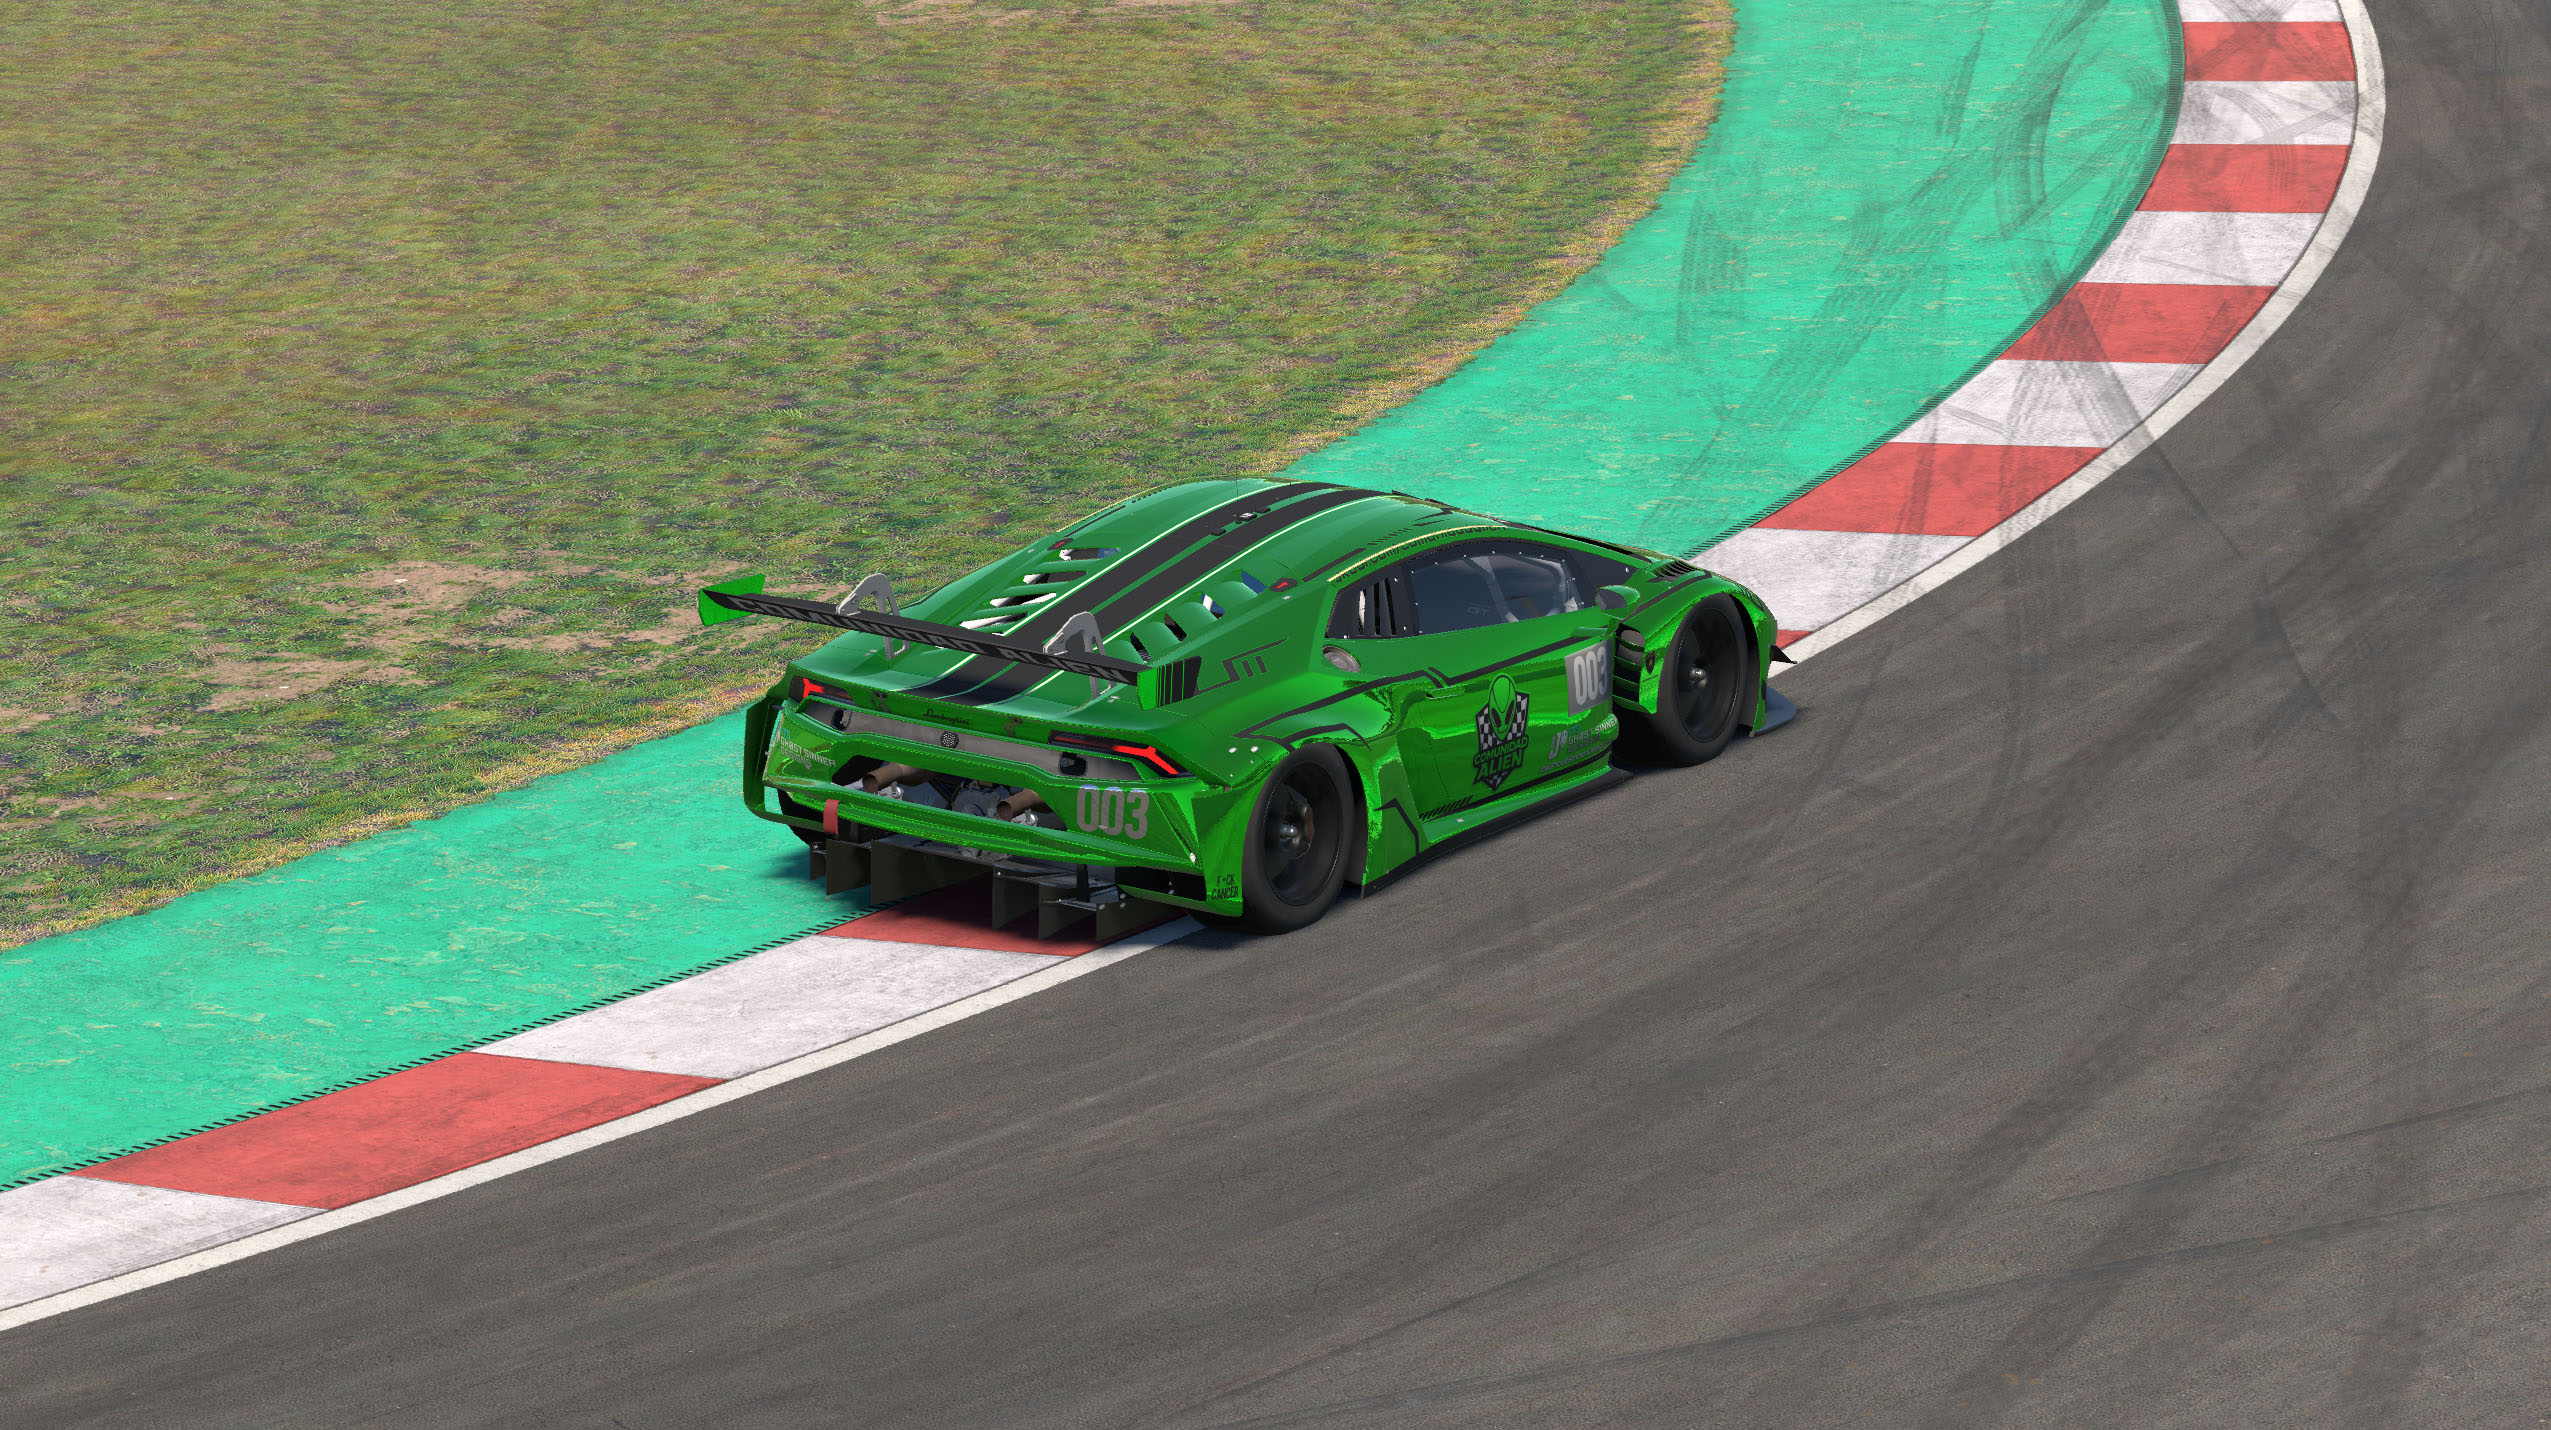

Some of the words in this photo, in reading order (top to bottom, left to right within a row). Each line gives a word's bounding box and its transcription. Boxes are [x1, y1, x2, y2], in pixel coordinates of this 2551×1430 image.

[728, 596, 986, 655] COMUNIDAD
[997, 647, 1132, 684] ALIEN
[1573, 646, 1608, 705] 003
[923, 708, 969, 725] Lamborghini
[804, 748, 837, 768] SINNER
[1473, 735, 1529, 766] COMUNIDAD
[1477, 749, 1524, 779] ALIEN
[1077, 784, 1149, 840] 003
[1212, 886, 1239, 900] CANCER
